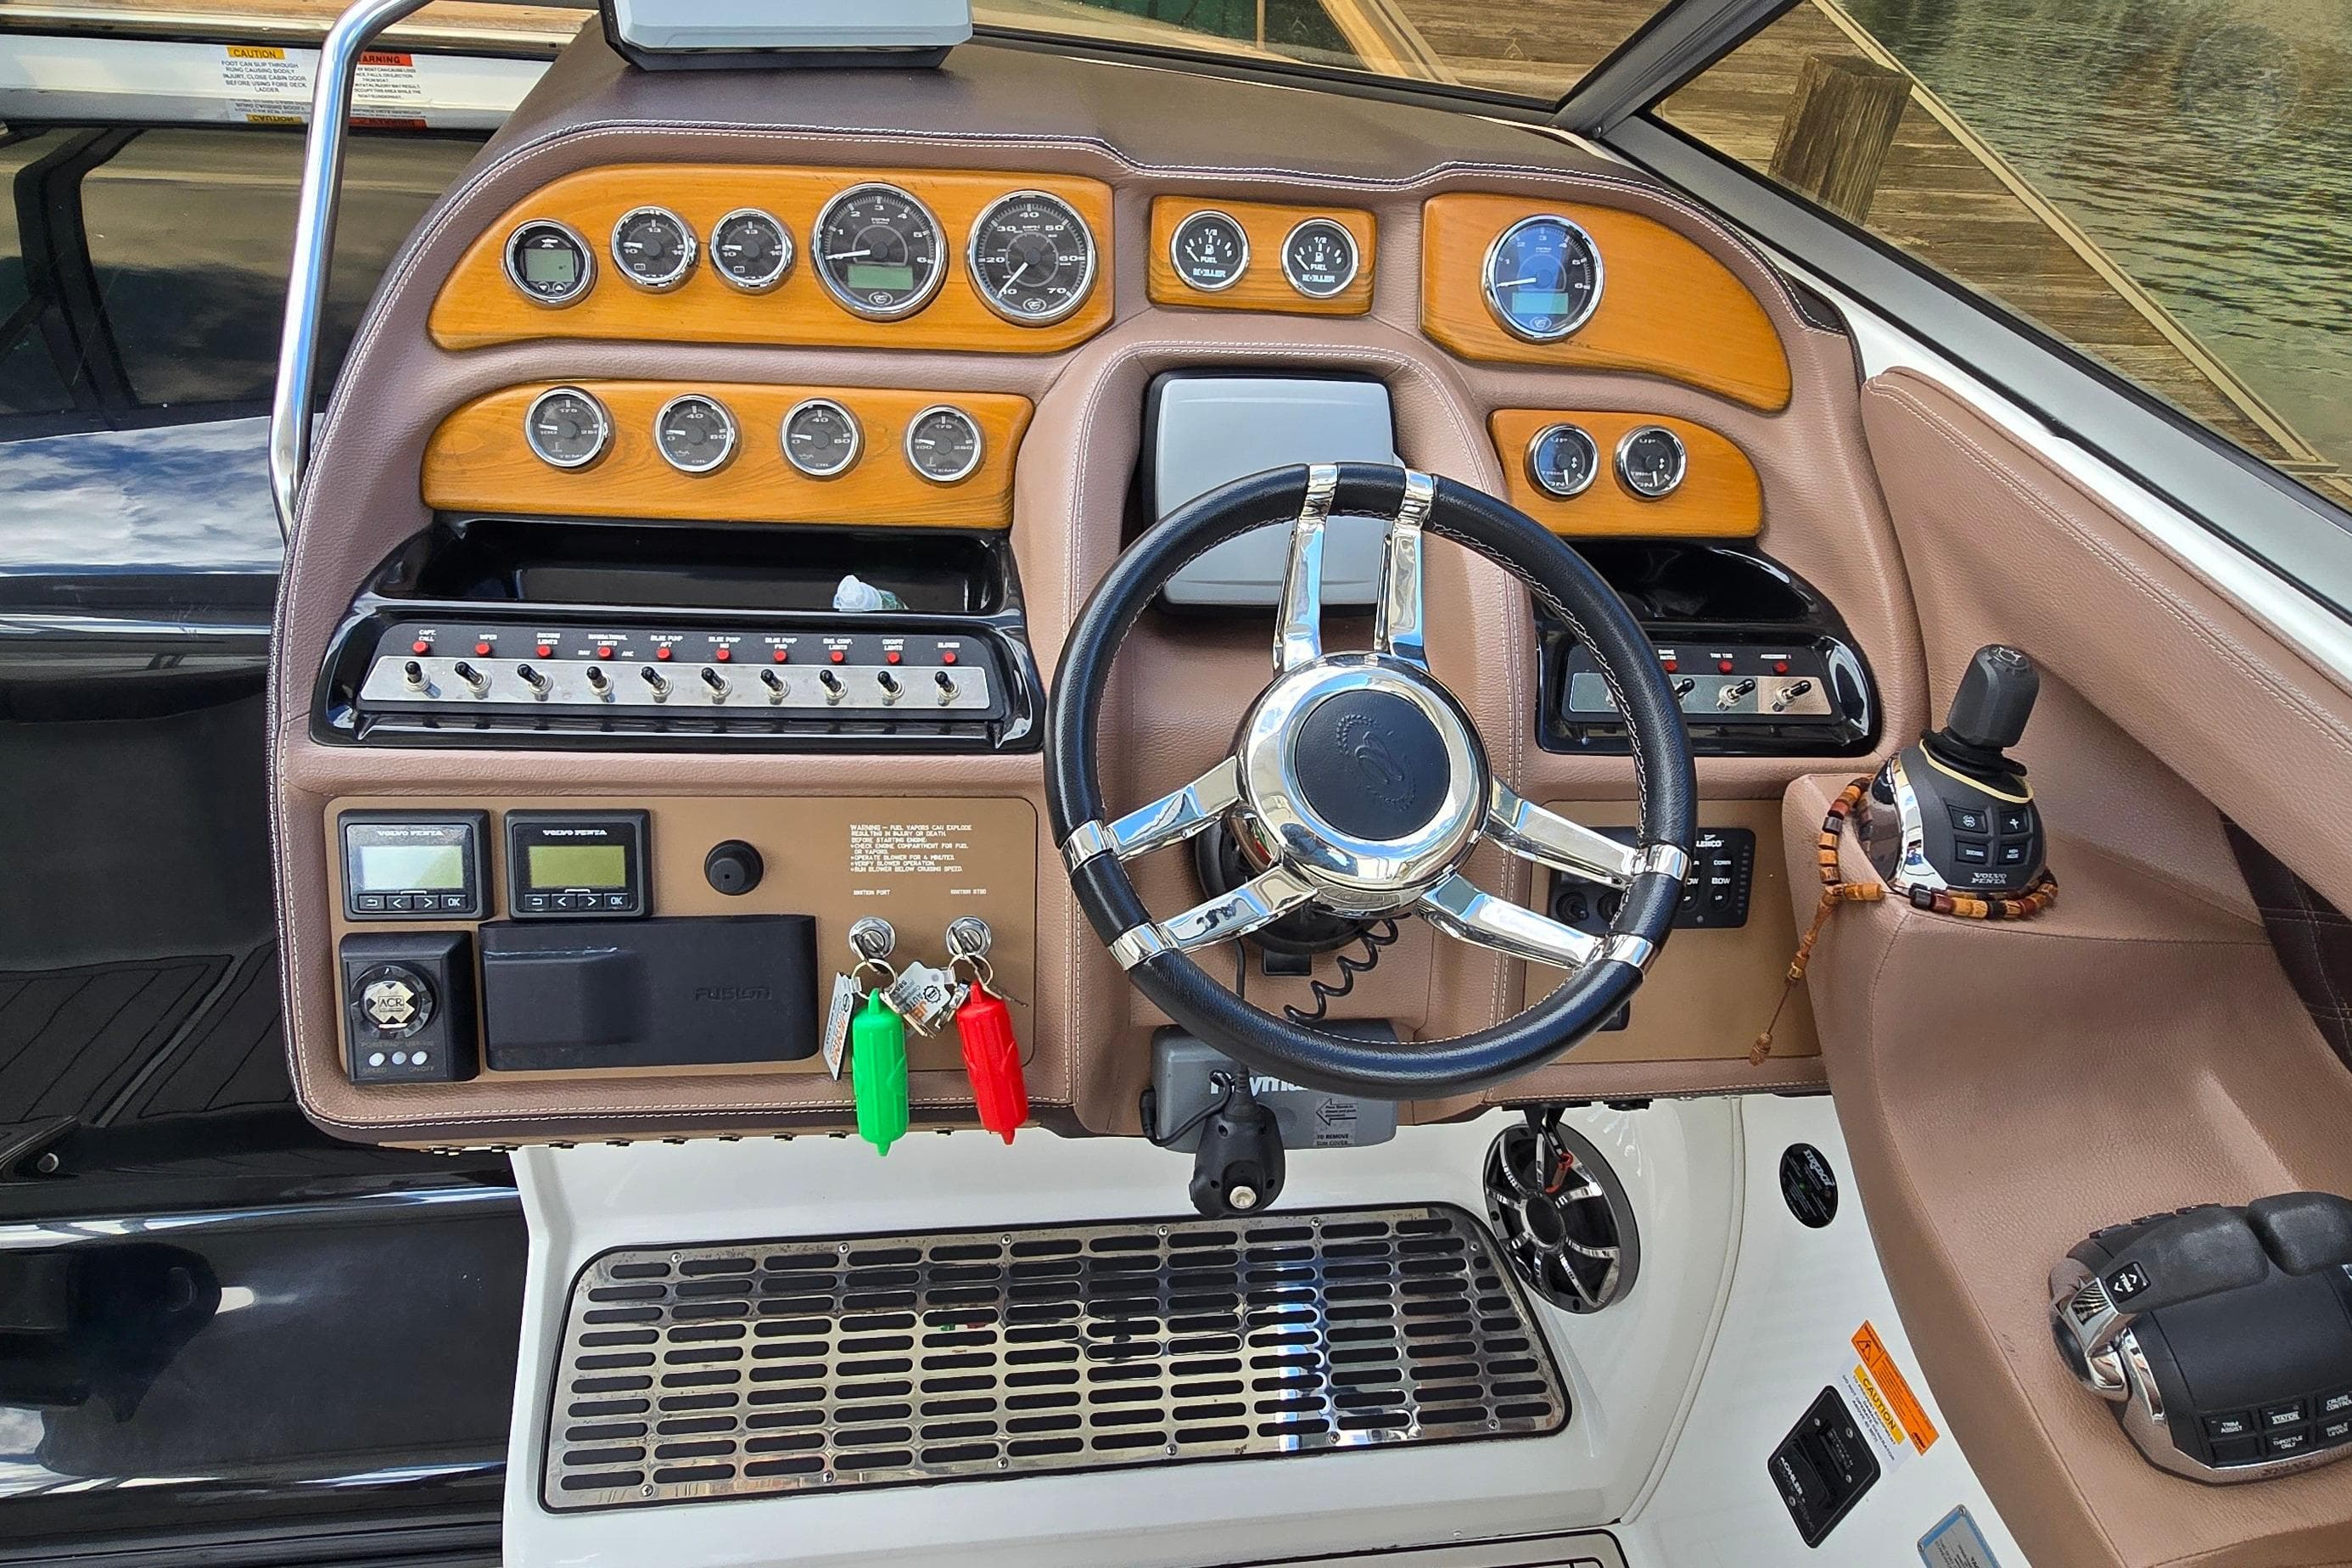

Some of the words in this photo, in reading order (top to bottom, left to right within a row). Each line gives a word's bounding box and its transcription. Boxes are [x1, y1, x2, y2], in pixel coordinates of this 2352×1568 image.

[233, 48, 277, 59] CAUTION
[448, 898, 461, 906] OK
[695, 986, 772, 1002] FUSION
[380, 998, 403, 1007] ACR
[1862, 1378, 1896, 1430] CAUTION
[2327, 1394, 2349, 1406] CRUISE
[1852, 1400, 1865, 1420] ABOVE
[1863, 1400, 1879, 1425] DAMAGE
[2271, 1410, 2300, 1425] STATION
[1843, 1375, 1849, 1384] DO
[1856, 1397, 1873, 1423] OPERATE
[1872, 1424, 1895, 1461] GENERATOR
[2220, 1425, 2243, 1434] ASSIST
[2273, 1435, 2303, 1446] THROTTLE
[1779, 1456, 1804, 1495] KOHLER
